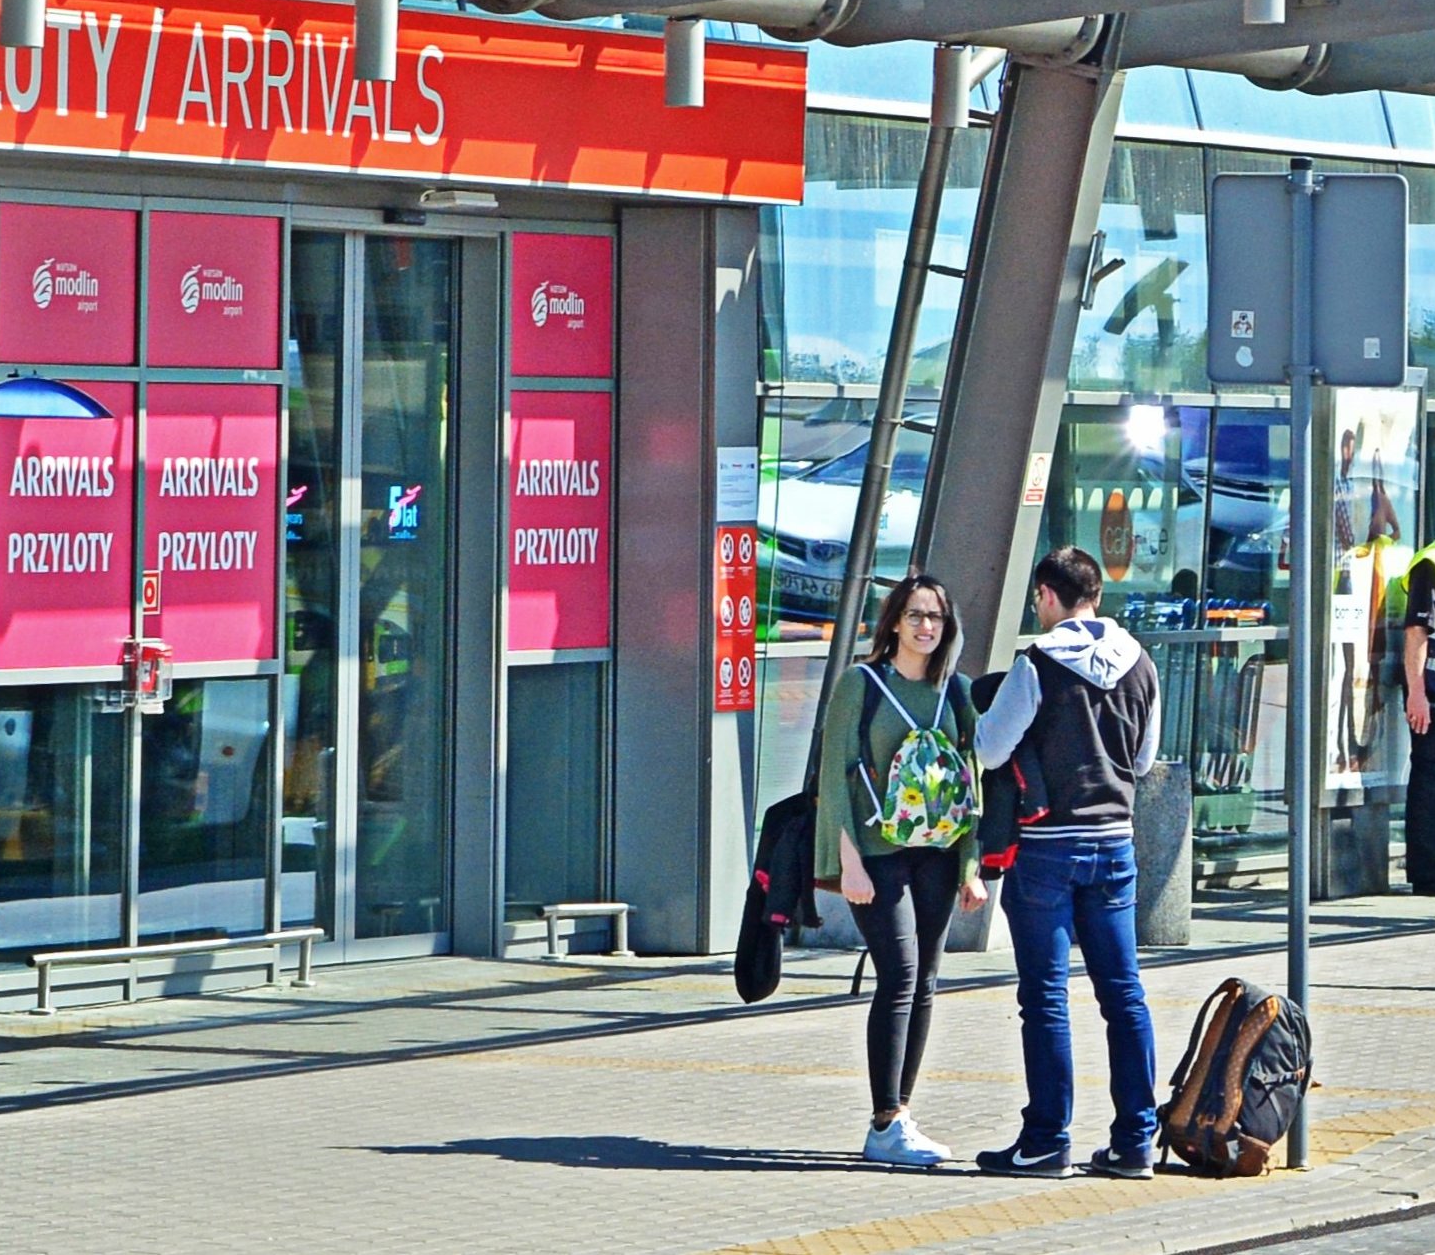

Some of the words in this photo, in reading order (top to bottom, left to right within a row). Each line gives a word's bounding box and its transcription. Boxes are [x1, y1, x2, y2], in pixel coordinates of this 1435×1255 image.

[176, 22, 446, 145] ARRIVALS
[55, 270, 97, 295] modlin
[202, 277, 242, 299] modlin
[549, 292, 583, 313] modlin
[10, 456, 113, 495] ARRIVALS
[159, 458, 257, 495] ARRIVALS
[516, 459, 598, 495] ARRIVALS
[7, 532, 110, 572] PRZYLOTY
[158, 530, 256, 569] PRZYLOTY
[514, 527, 597, 564] PRZYLOTY
